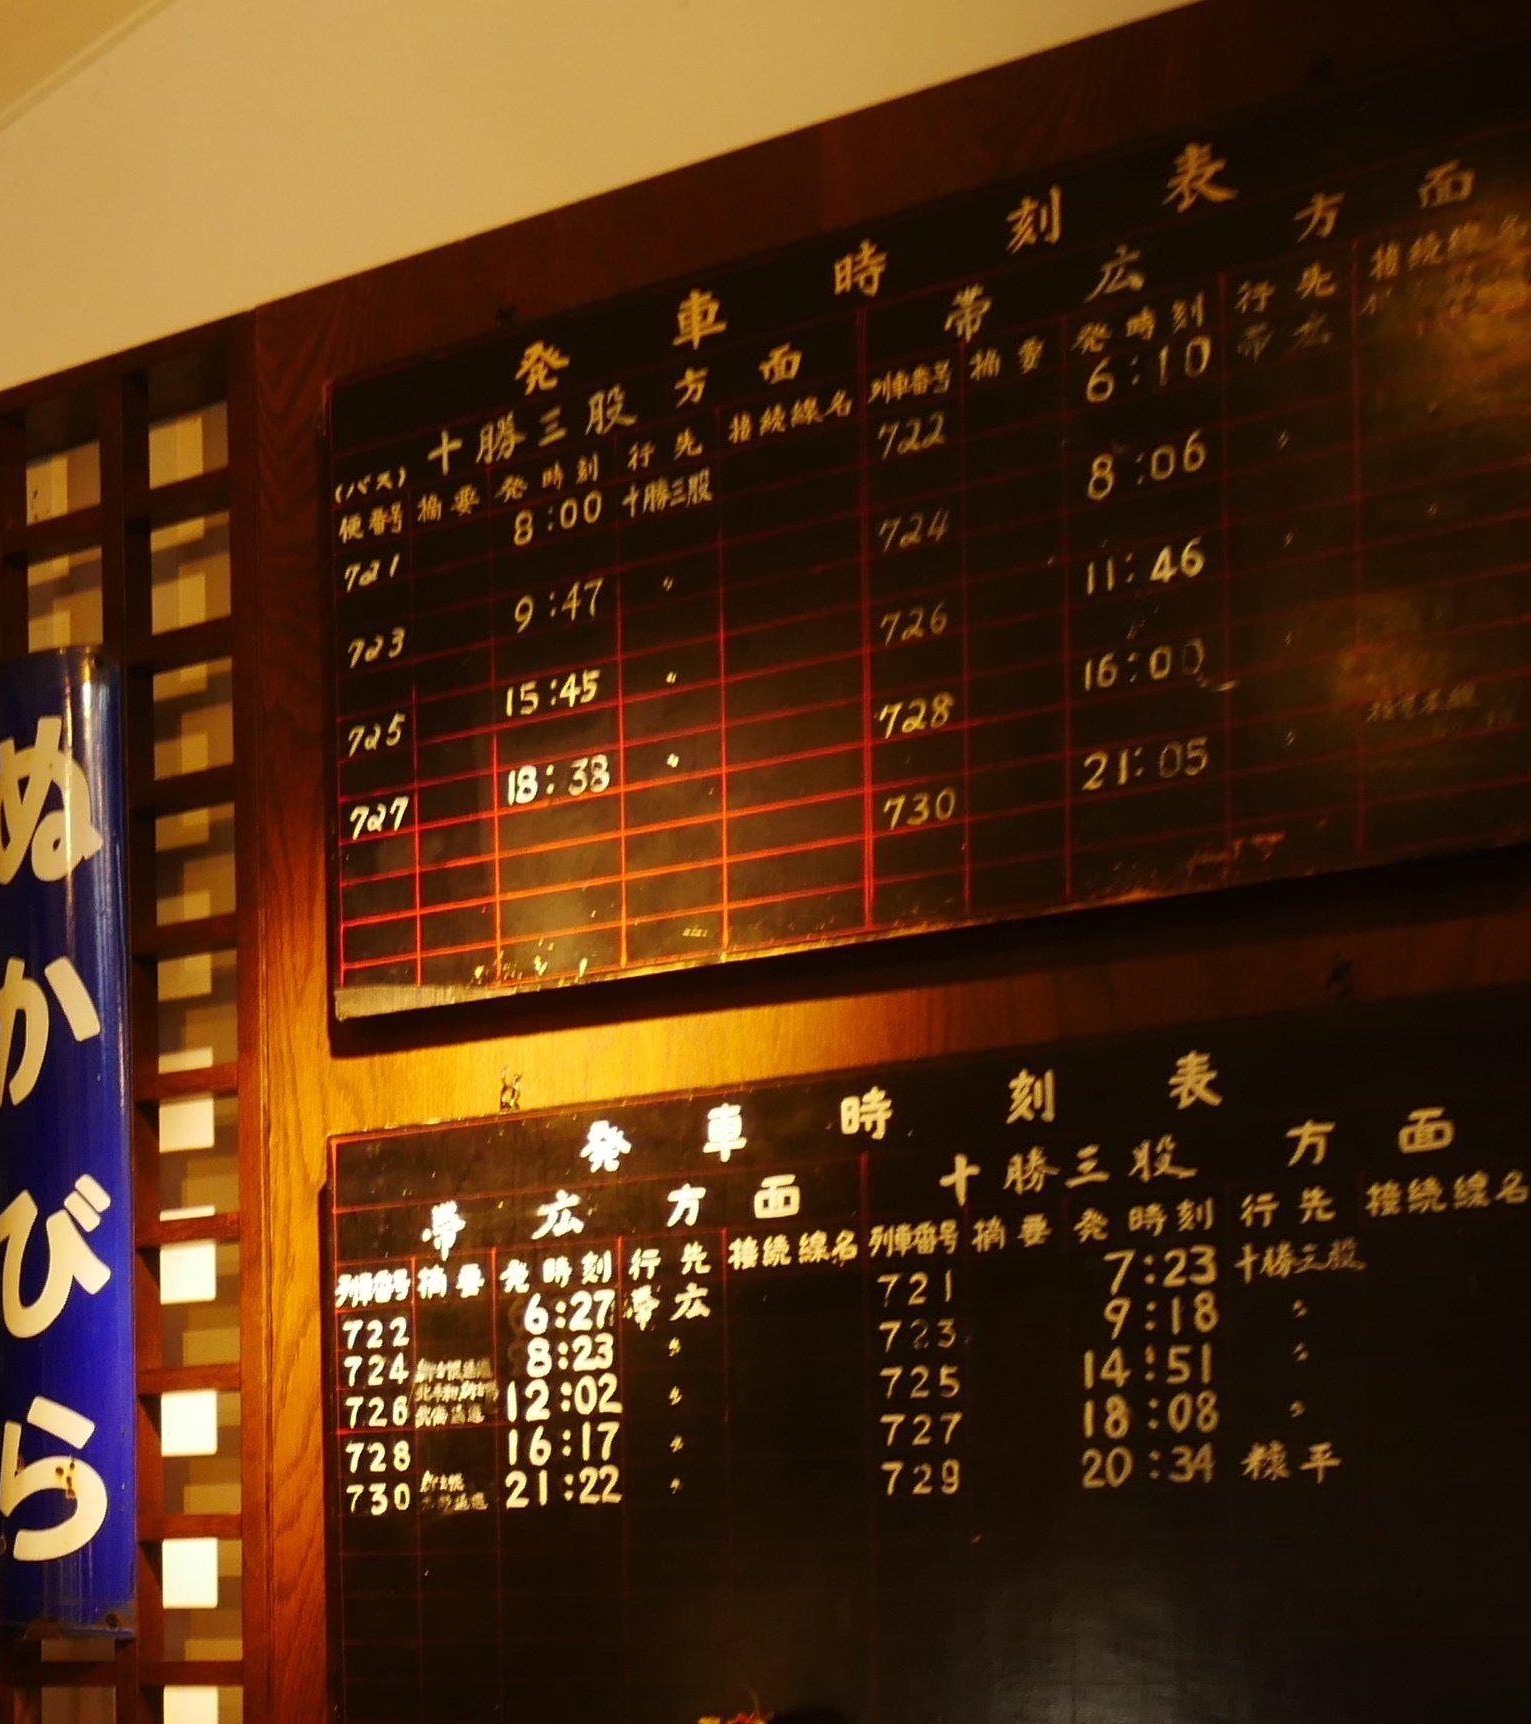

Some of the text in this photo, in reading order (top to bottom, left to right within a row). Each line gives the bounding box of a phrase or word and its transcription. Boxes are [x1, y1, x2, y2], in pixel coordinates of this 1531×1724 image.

[877, 412, 944, 459] 722
[1086, 336, 1210, 402] 6:10
[878, 430, 1206, 552] 724 8:06
[344, 554, 399, 592] 721
[514, 490, 601, 547] 8:00
[348, 577, 603, 669] 723 9:47
[880, 537, 1205, 646] 726 11:46
[349, 670, 600, 755] 725 15:45
[877, 638, 1205, 739] 728 16:00
[350, 755, 611, 839] 727 18:38
[884, 737, 1208, 831] 730 21:05
[581, 1050, 1222, 1173] 発車時刻表
[940, 1107, 1454, 1206] 十勝三股方面
[877, 1269, 954, 1309] 721
[1103, 1244, 1219, 1295] 7:23
[342, 1317, 409, 1351] 722
[523, 1290, 616, 1335] 6:27
[343, 1356, 409, 1388] 724
[527, 1336, 615, 1379] 8:23
[879, 1290, 1219, 1353] 723 9:18
[344, 1396, 409, 1429] 726
[505, 1375, 623, 1423] 12:02
[880, 1343, 1213, 1399] 725 14:51
[345, 1422, 621, 1474] 728 16:17
[880, 1393, 1219, 1448] 727 18:08
[346, 1464, 623, 1516] 730 21:22
[880, 1459, 960, 1496] 729
[1082, 1444, 1214, 1490] 20:34
